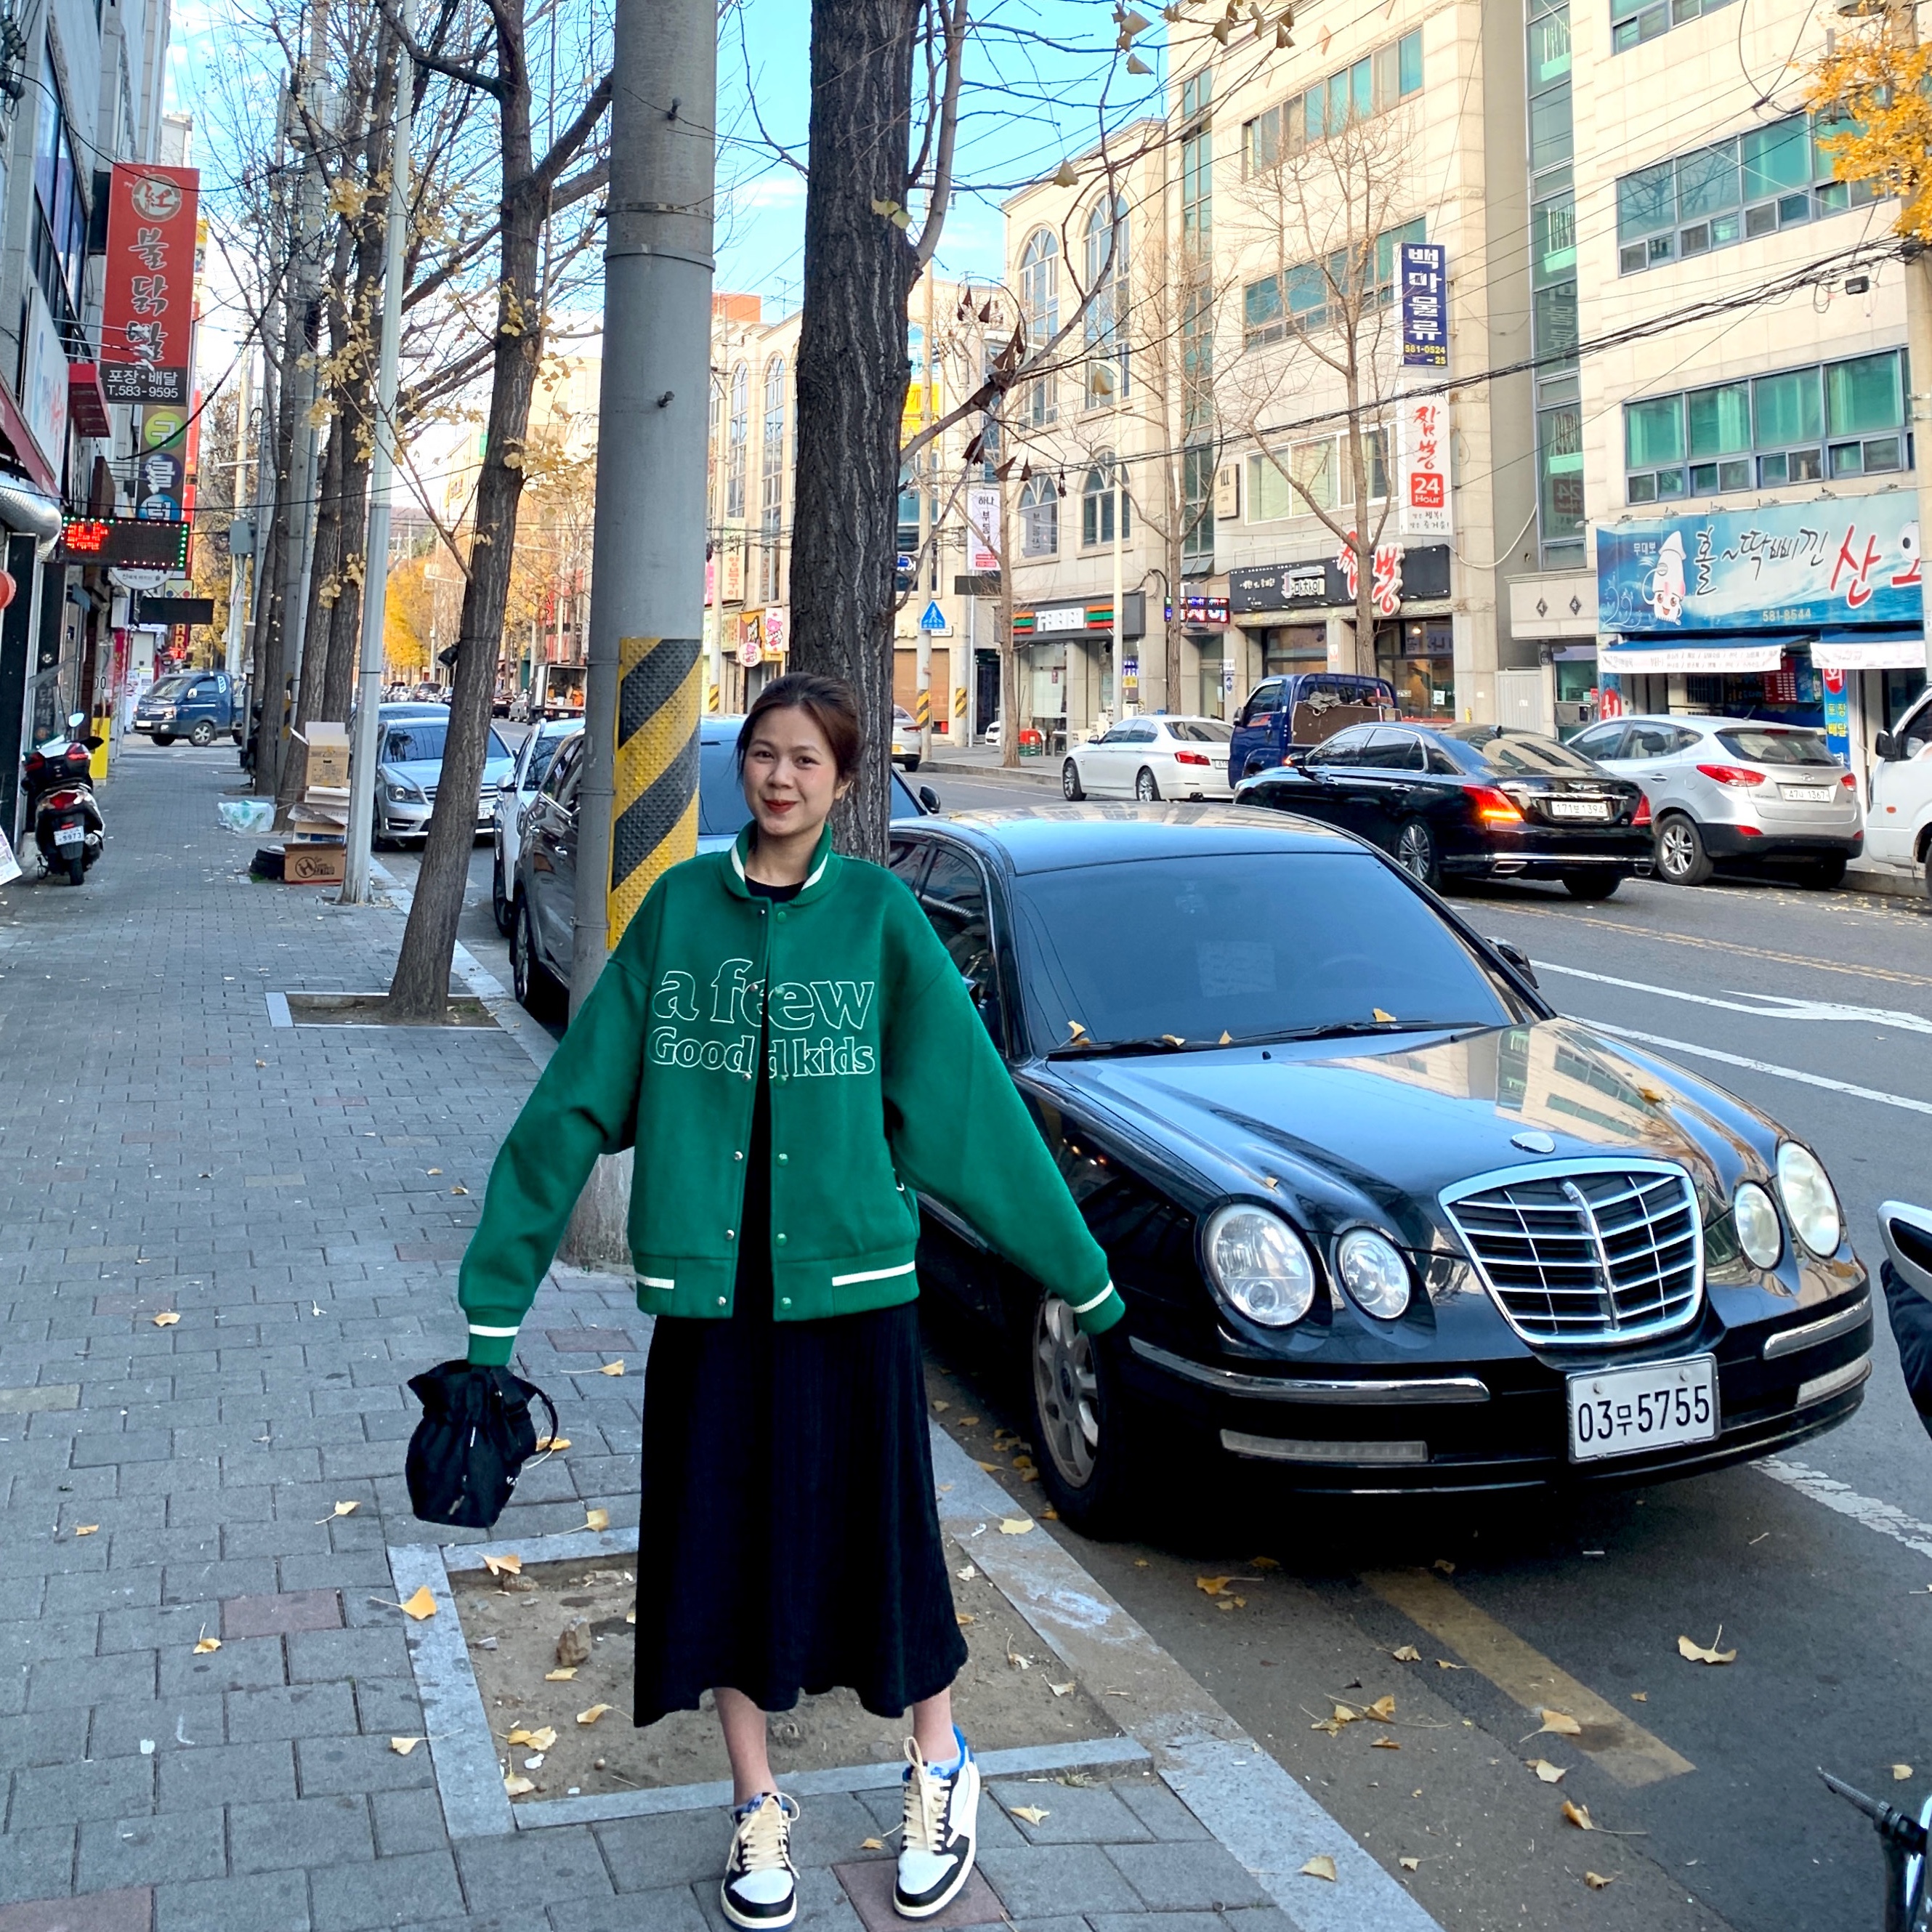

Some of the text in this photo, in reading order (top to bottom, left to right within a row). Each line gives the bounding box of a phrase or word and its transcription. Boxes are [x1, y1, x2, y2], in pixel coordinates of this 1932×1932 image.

[1408, 248, 1442, 341] 백마물류
[1404, 344, 1446, 355] 581-0524
[107, 384, 179, 399] T.583-9595
[1414, 477, 1441, 495] 24
[978, 496, 995, 506] 하나
[1415, 495, 1441, 504] Hour
[1762, 607, 1811, 623] 581-8544
[1827, 722, 1847, 737] 배달
[653, 970, 700, 1022] a
[648, 1026, 756, 1074] Good
[792, 1035, 876, 1078] kids
[1578, 1384, 1710, 1442] 03무5755
